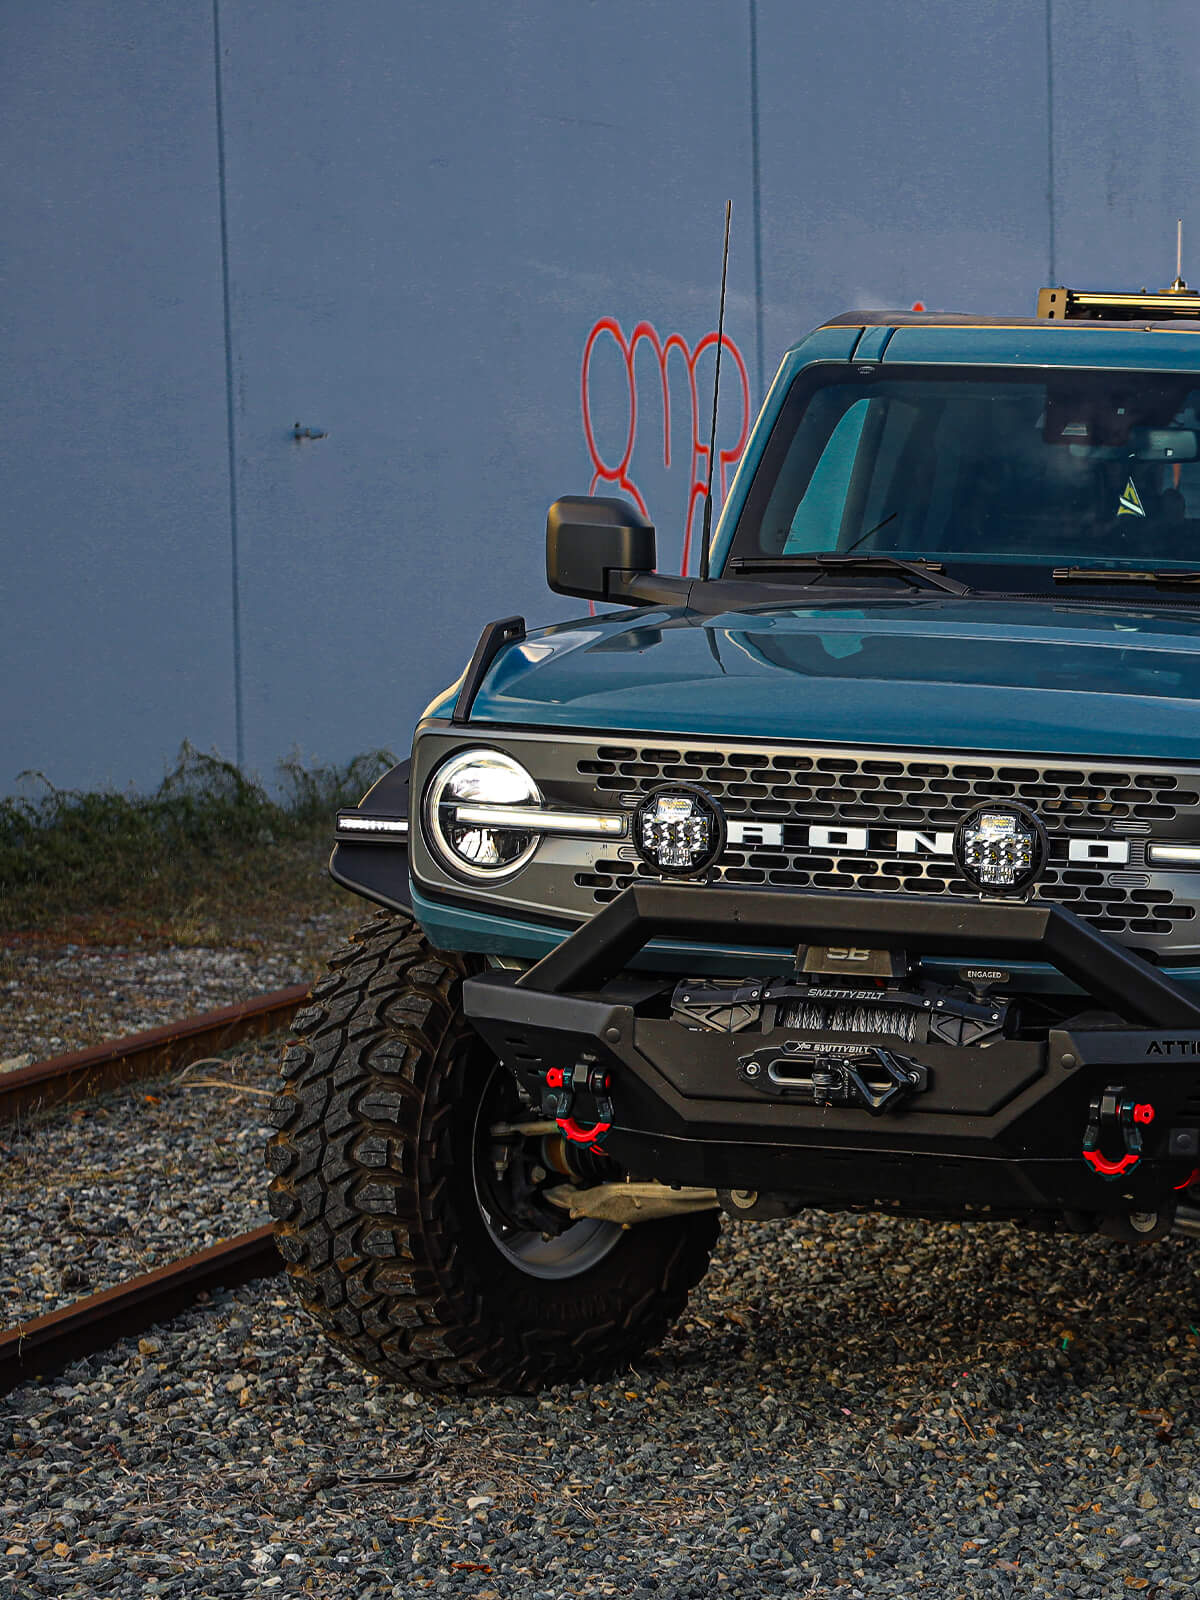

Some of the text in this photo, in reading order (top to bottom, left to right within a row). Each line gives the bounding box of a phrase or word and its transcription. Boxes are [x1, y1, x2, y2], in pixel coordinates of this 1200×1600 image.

[727, 820, 1129, 864] RONO
[967, 970, 1002, 979] ENGAGED
[808, 988, 885, 1000] SMITTYBILT
